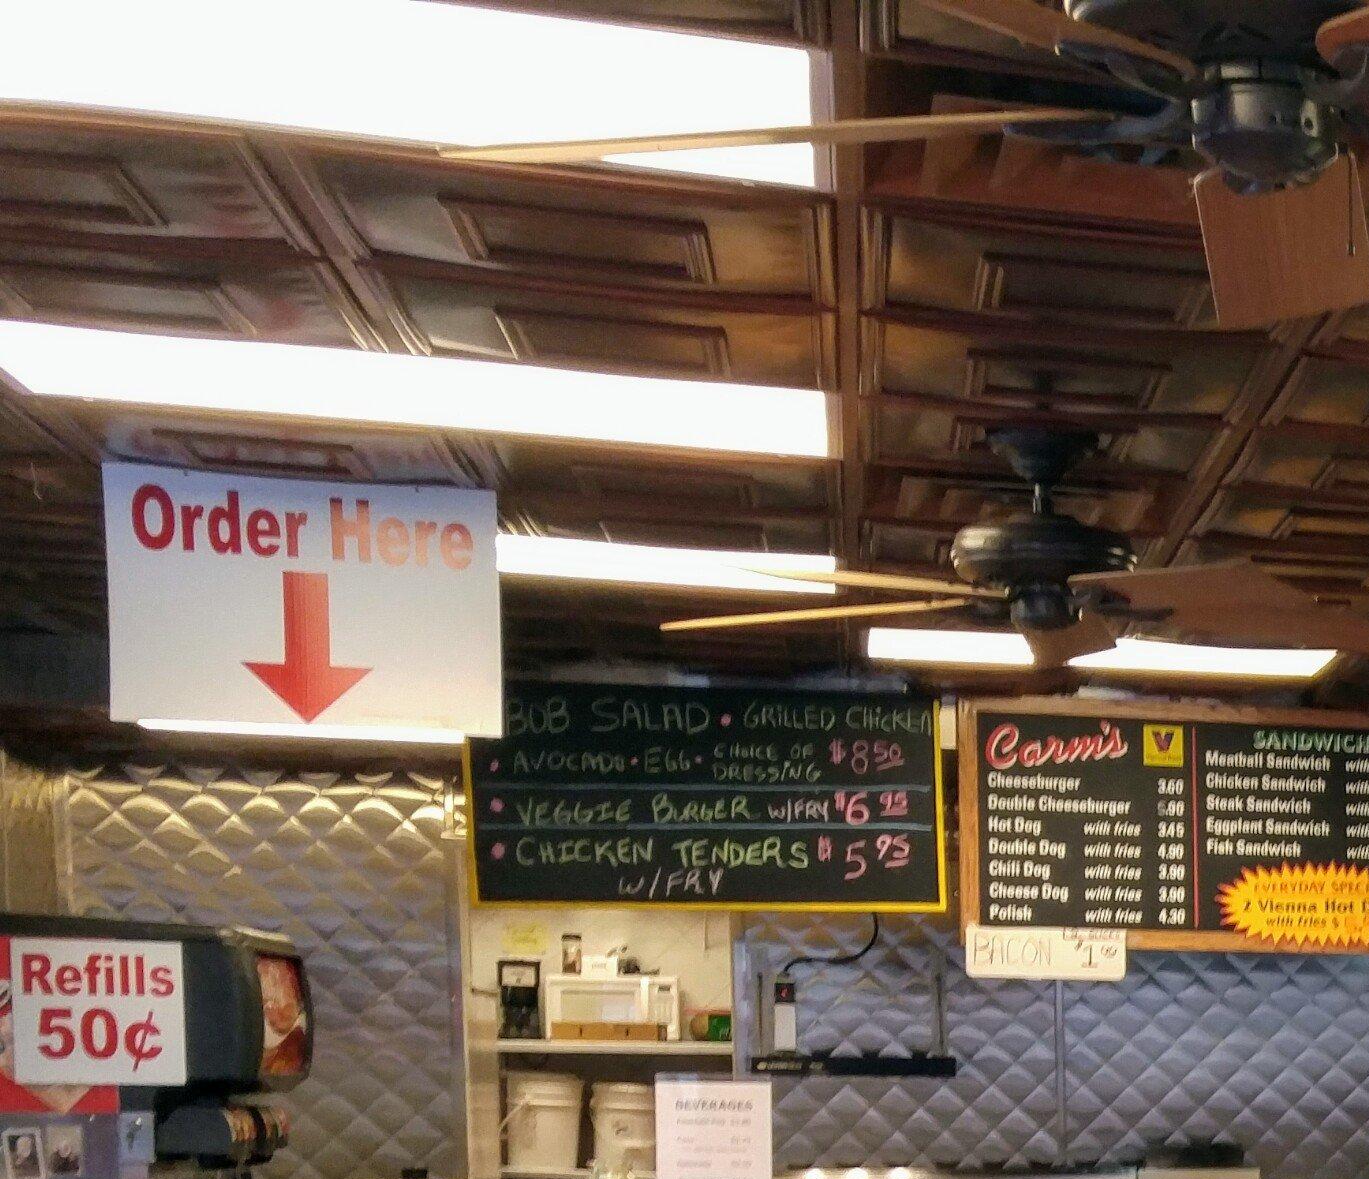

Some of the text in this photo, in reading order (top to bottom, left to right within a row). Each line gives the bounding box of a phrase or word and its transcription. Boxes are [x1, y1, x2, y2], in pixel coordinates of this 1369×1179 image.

[132, 483, 474, 570] Order Here
[591, 697, 711, 734] SALAD
[714, 742, 779, 762] CHOICE
[984, 719, 1128, 770] Carm's
[644, 747, 690, 773] EGG
[1205, 750, 1263, 768] Meatball
[1266, 752, 1331, 772] Sandwich
[712, 761, 823, 783] DRESSING
[987, 771, 1081, 793] Cheeseburger
[1205, 772, 1259, 789] Chicken
[1262, 774, 1326, 793] Sandwich
[516, 796, 632, 827] VEGGIE
[988, 793, 1132, 818] Double Cheeseburger
[1206, 794, 1243, 811] Steak
[1246, 796, 1311, 814] Sandwich
[988, 816, 1142, 837] Hot Dog with fries
[1206, 815, 1263, 836] Eggplant
[1266, 818, 1331, 837] Sandwich
[516, 835, 810, 870] CHICKEN TENDERS
[988, 837, 1143, 859] Double Dog with fries
[1206, 838, 1233, 855] Fish
[1236, 839, 1301, 858] Sandwich
[989, 859, 1143, 881] Chili Dog with fries
[989, 881, 1143, 903] Cheese Dog with fries
[1254, 882, 1326, 894] EVERYDAY
[989, 903, 1143, 924] Polish with fries
[1258, 900, 1317, 914] Vienna
[1324, 899, 1354, 914] Hot
[1266, 915, 1327, 927] with fries
[973, 932, 1051, 966] BACON
[21, 953, 176, 997] Refills
[37, 1008, 163, 1072] 50¢
[675, 1099, 753, 1112] BEVERAGES
